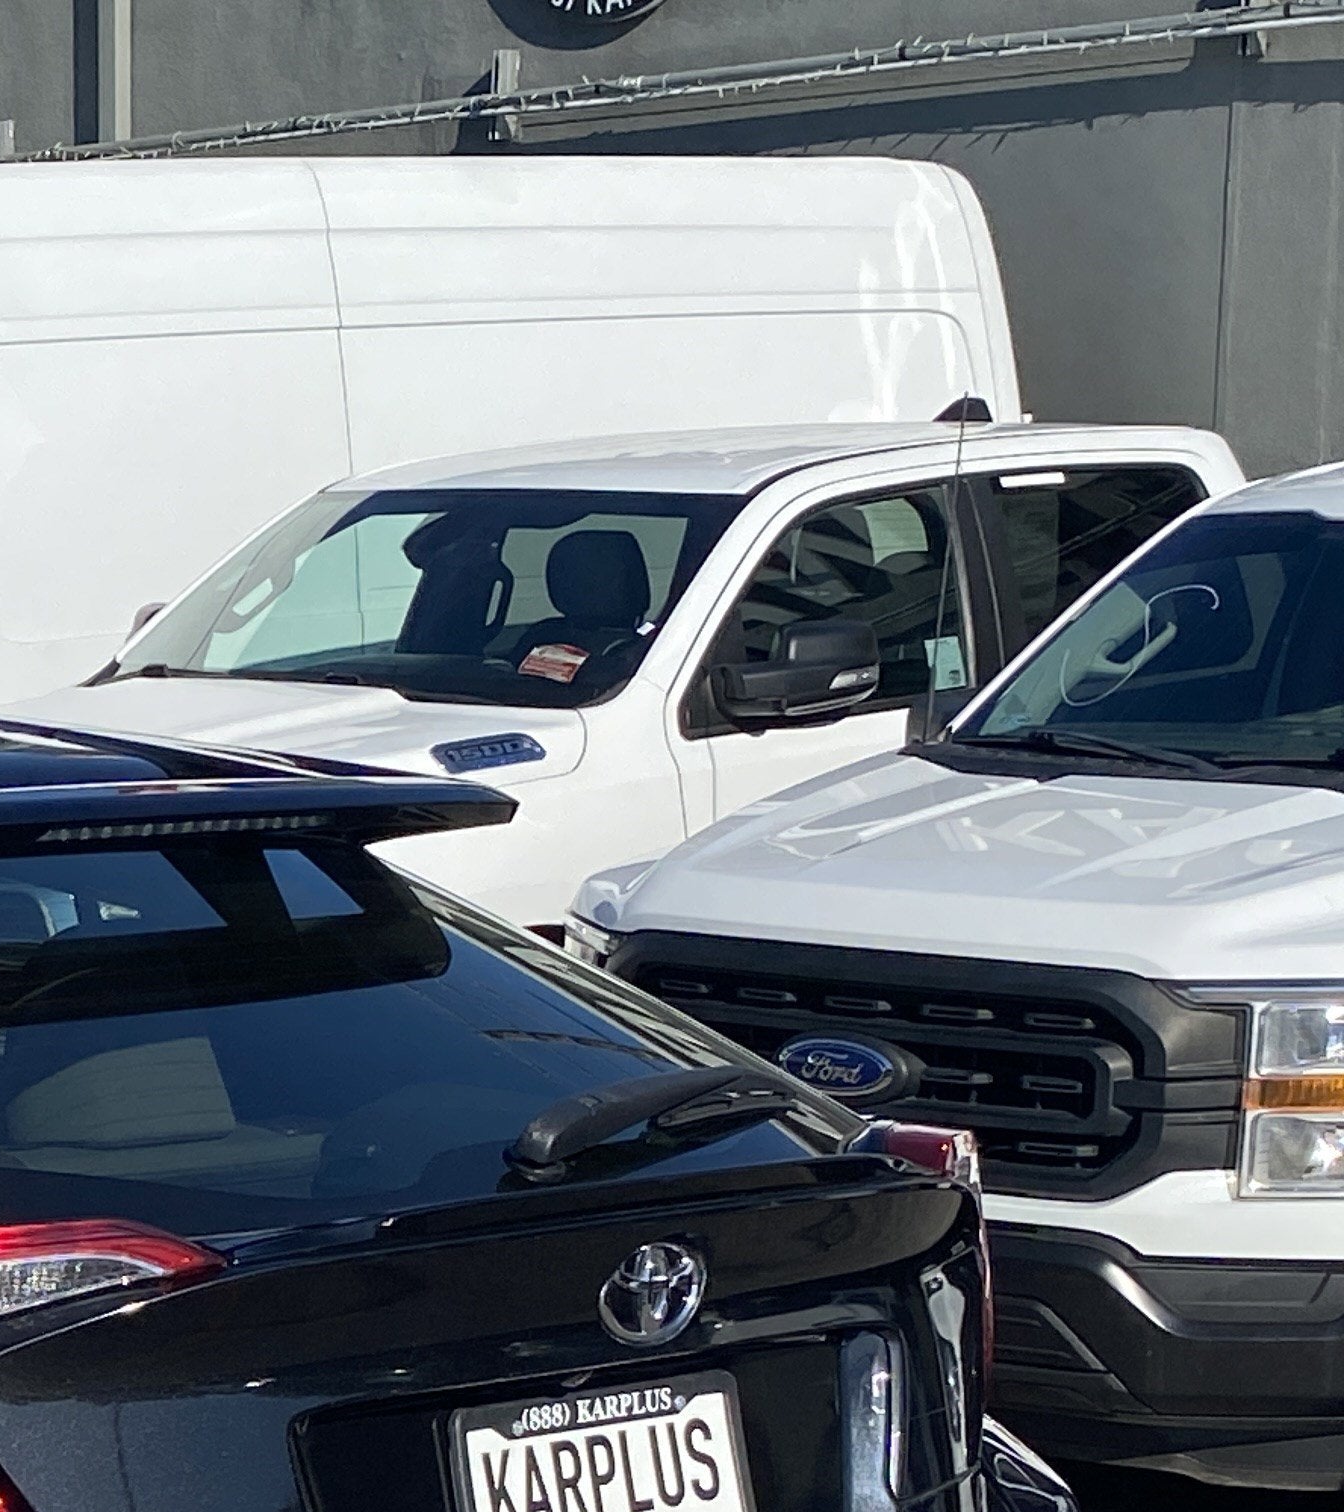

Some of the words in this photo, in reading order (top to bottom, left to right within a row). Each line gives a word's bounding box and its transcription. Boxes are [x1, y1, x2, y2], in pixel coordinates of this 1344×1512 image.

[800, 1051, 863, 1085] Ford
[521, 1402, 570, 1432] (888)
[576, 1386, 673, 1424] KARPLUS
